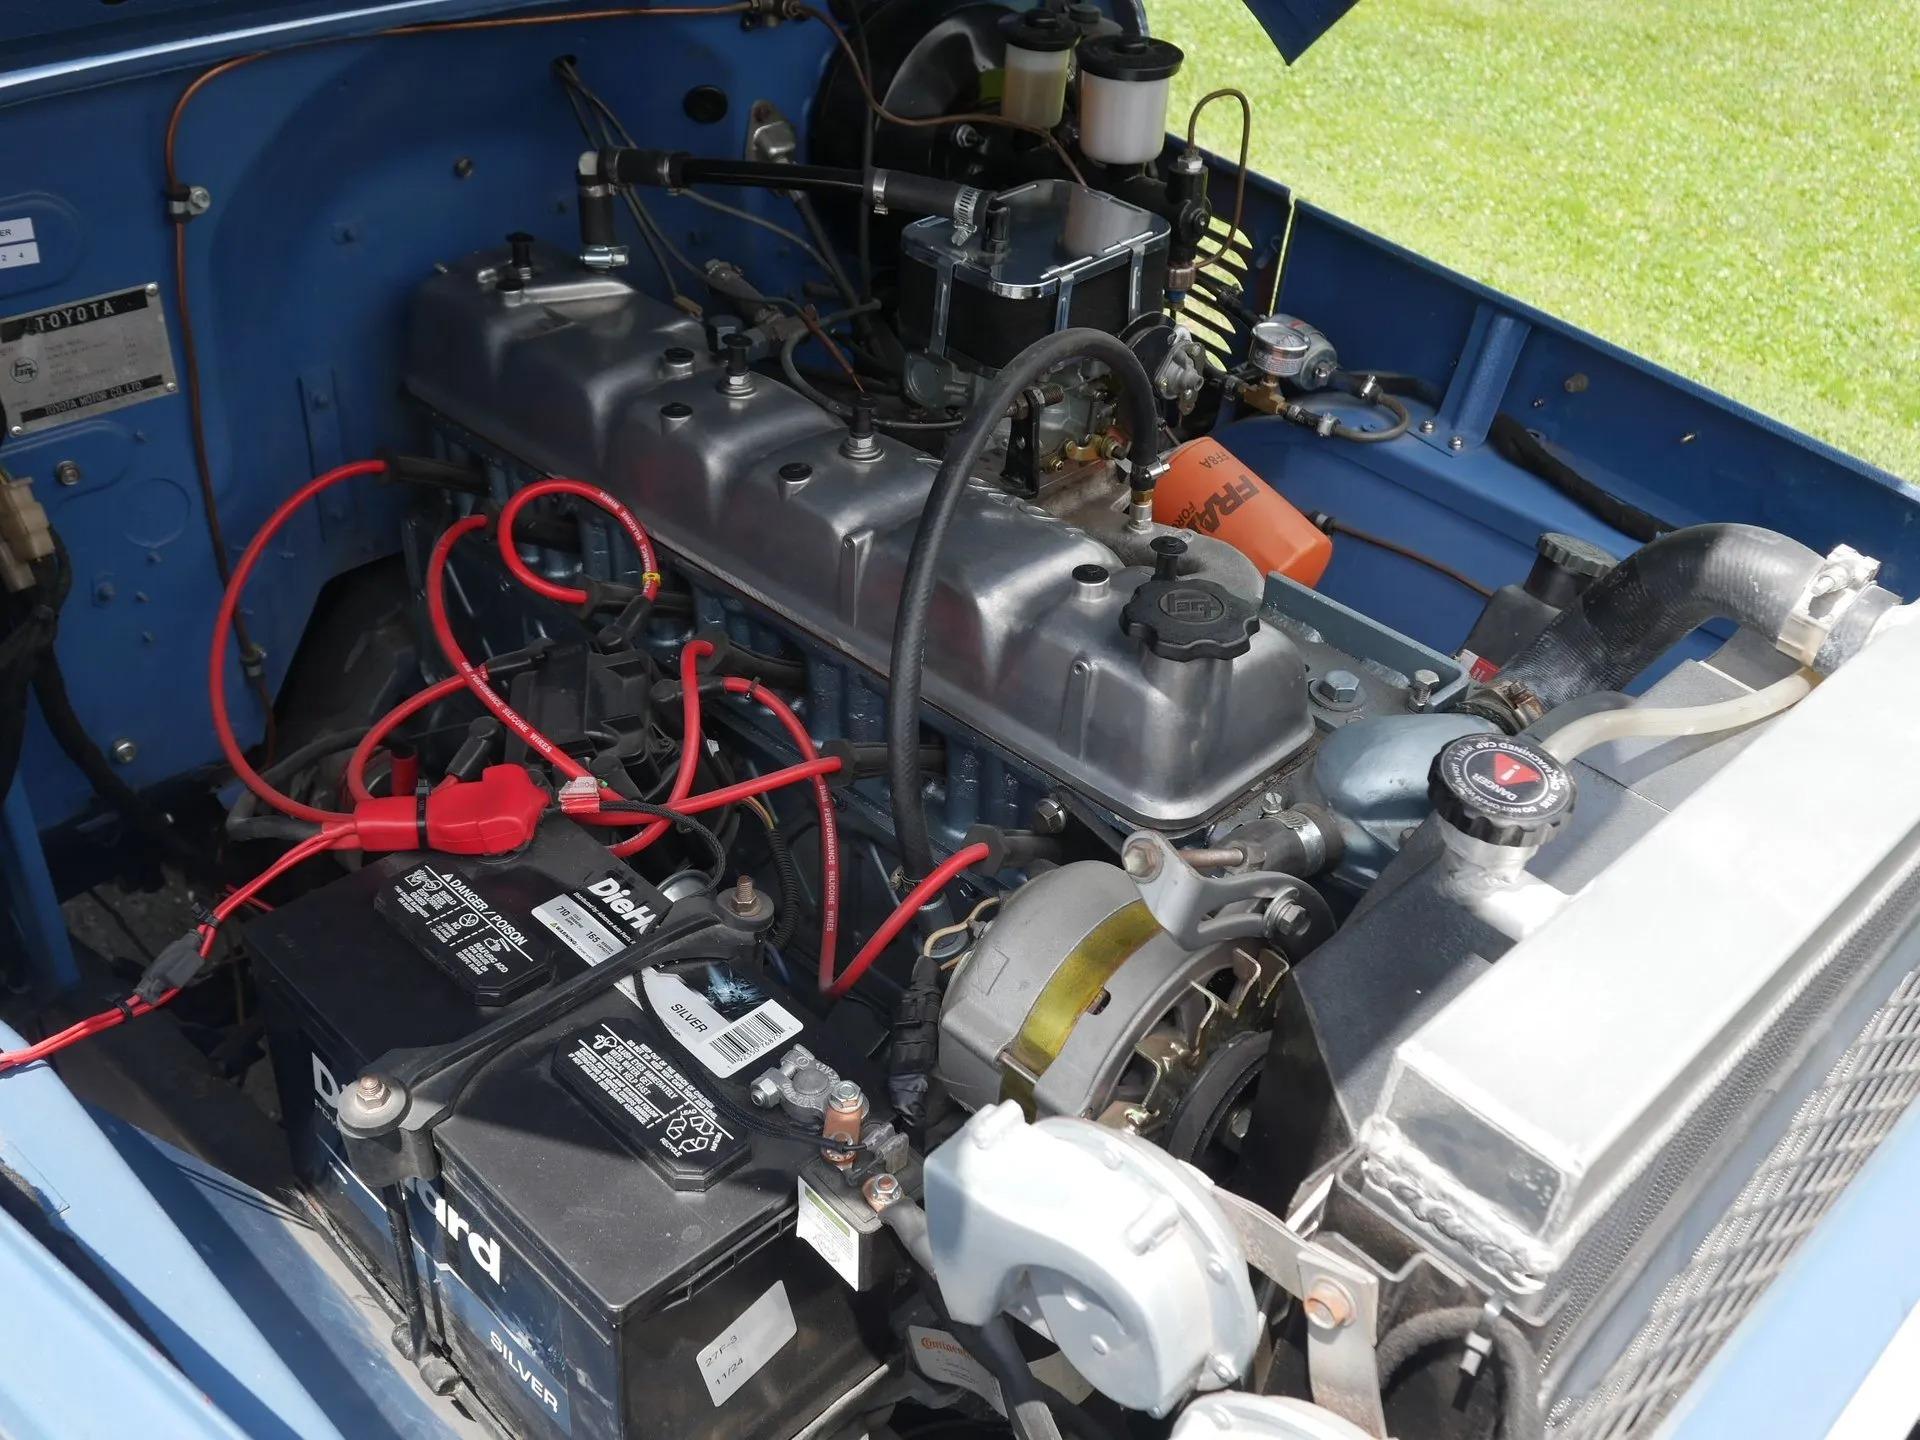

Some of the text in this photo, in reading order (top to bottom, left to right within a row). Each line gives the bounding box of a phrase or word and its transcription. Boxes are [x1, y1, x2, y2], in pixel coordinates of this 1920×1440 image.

[35, 300, 115, 331] TOYOTA
[502, 707, 529, 732] SILICONE
[530, 733, 553, 753] WIRES
[1476, 741, 1498, 750] CAP
[1498, 742, 1554, 773] MACHINED
[1471, 773, 1518, 801] DANGER
[824, 808, 835, 865] PERFORMANCE
[416, 888, 443, 910] EXPLOSIVE
[432, 894, 447, 906] EYES
[439, 890, 457, 905] SHIELD
[450, 879, 489, 911] DANGER
[490, 914, 528, 947] POISON
[556, 905, 570, 917] 710
[587, 878, 657, 935] DieH
[555, 926, 578, 946] WARNING:
[585, 931, 601, 943] 165
[473, 942, 509, 973] SULFURIC ACID
[670, 1003, 708, 1033] SILVER
[602, 1052, 651, 1095] MEDICAL HELP FAST
[609, 1049, 624, 1062] WITH
[639, 1076, 653, 1087] GET
[615, 1045, 678, 1099] FLUSH EYES IMMEDIATELY
[633, 1045, 644, 1055] NOT
[650, 1060, 663, 1071] KEEP
[661, 1069, 674, 1081] VENT
[671, 1078, 685, 1090] CAPS
[682, 1089, 697, 1101] TIGHT
[694, 1098, 706, 1109] AND
[639, 1043, 653, 1054] KEEP
[650, 1052, 661, 1062] OUT
[665, 1065, 676, 1075] THE
[673, 1073, 689, 1086] REACH
[693, 1090, 715, 1109] CHILDREN
[641, 1103, 659, 1118] FOLLOW
[659, 1136, 682, 1158] RECYCLE
[704, 1334, 739, 1368] 27F-3
[489, 1331, 559, 1414] SILVER
[715, 1356, 744, 1386] 11/24
